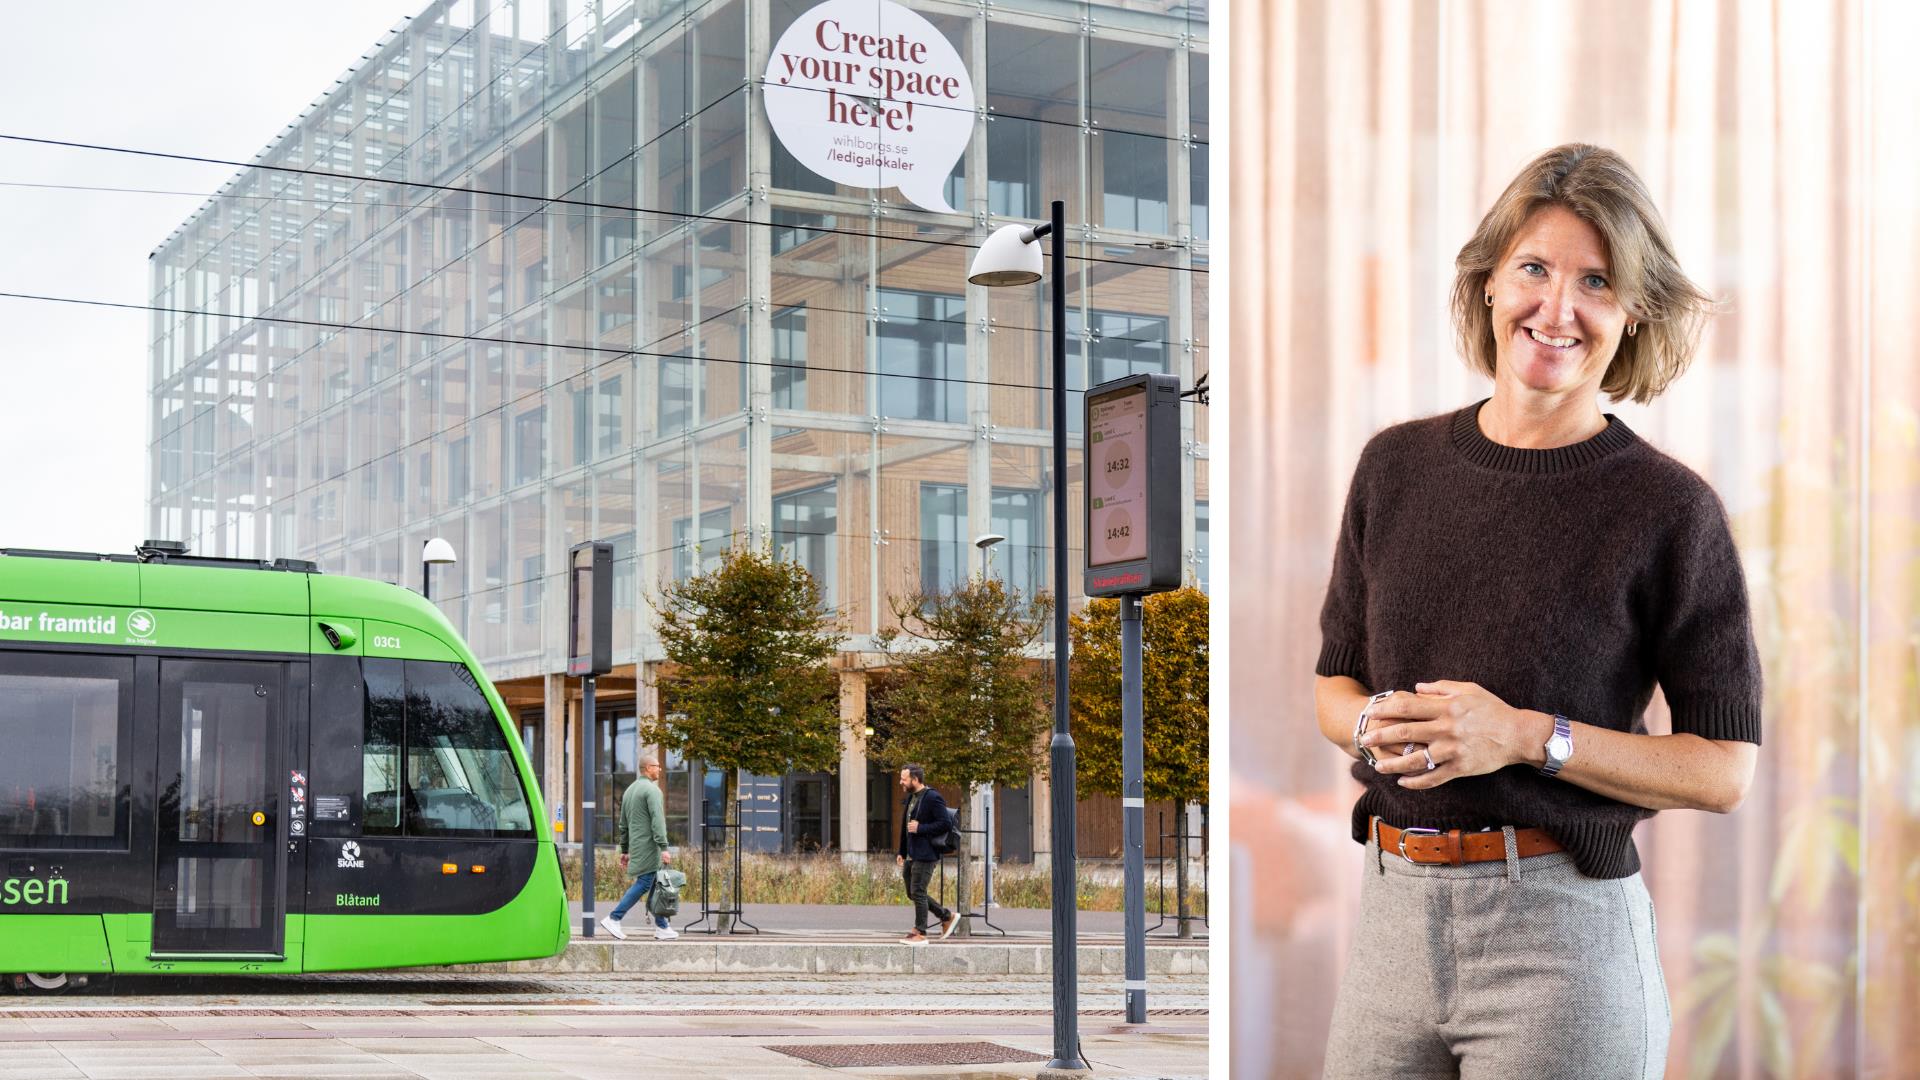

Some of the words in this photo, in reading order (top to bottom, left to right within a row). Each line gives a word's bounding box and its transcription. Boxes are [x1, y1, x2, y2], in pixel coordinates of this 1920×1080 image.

[816, 19, 928, 64] Create
[780, 53, 861, 85] your
[868, 66, 960, 99] space
[827, 88, 914, 132] here!
[833, 136, 908, 155] wihlborgs.se
[827, 149, 914, 171] /ledigalokaler
[1106, 458, 1130, 473] 14:32
[1107, 525, 1130, 540] 14:42
[0, 610, 32, 630] bar
[39, 612, 115, 634] framtid
[374, 635, 401, 648] 03C1
[0, 879, 68, 905] sen
[336, 893, 380, 906] Blåtand
